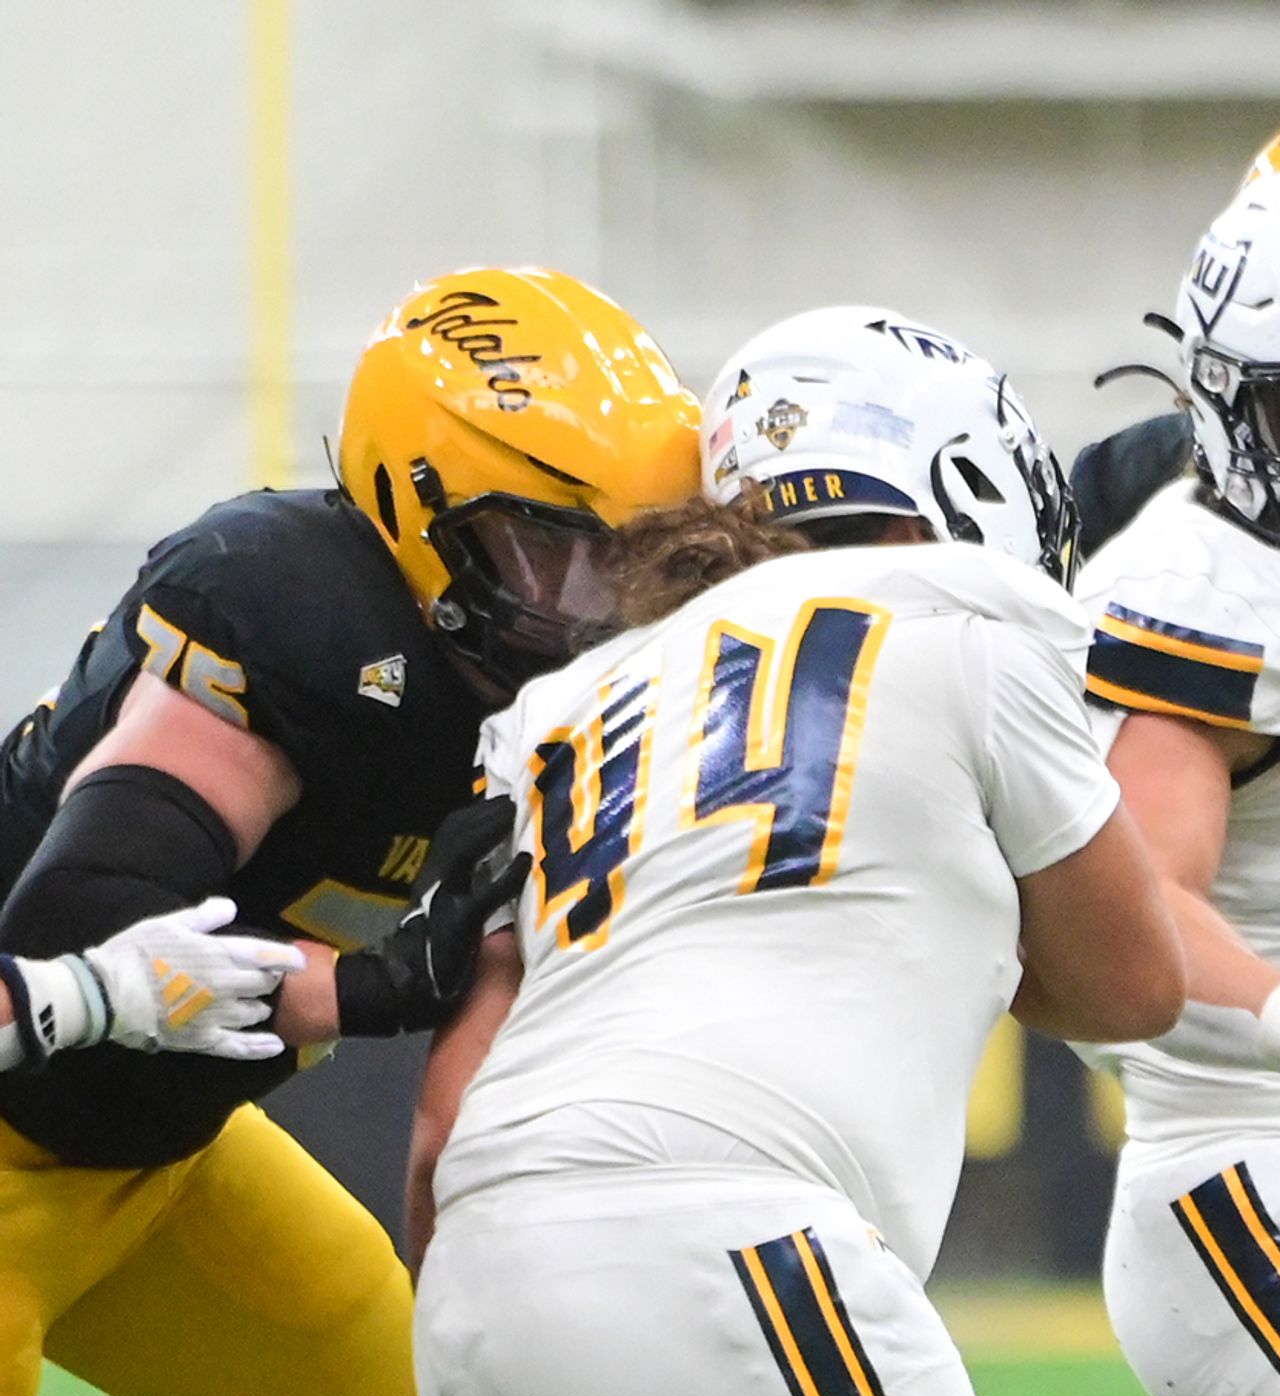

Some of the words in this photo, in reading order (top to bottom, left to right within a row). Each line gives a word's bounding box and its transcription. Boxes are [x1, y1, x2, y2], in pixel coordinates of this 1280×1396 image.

[406, 291, 542, 412] Idaho
[763, 473, 846, 513] THER
[526, 596, 894, 953] 44
